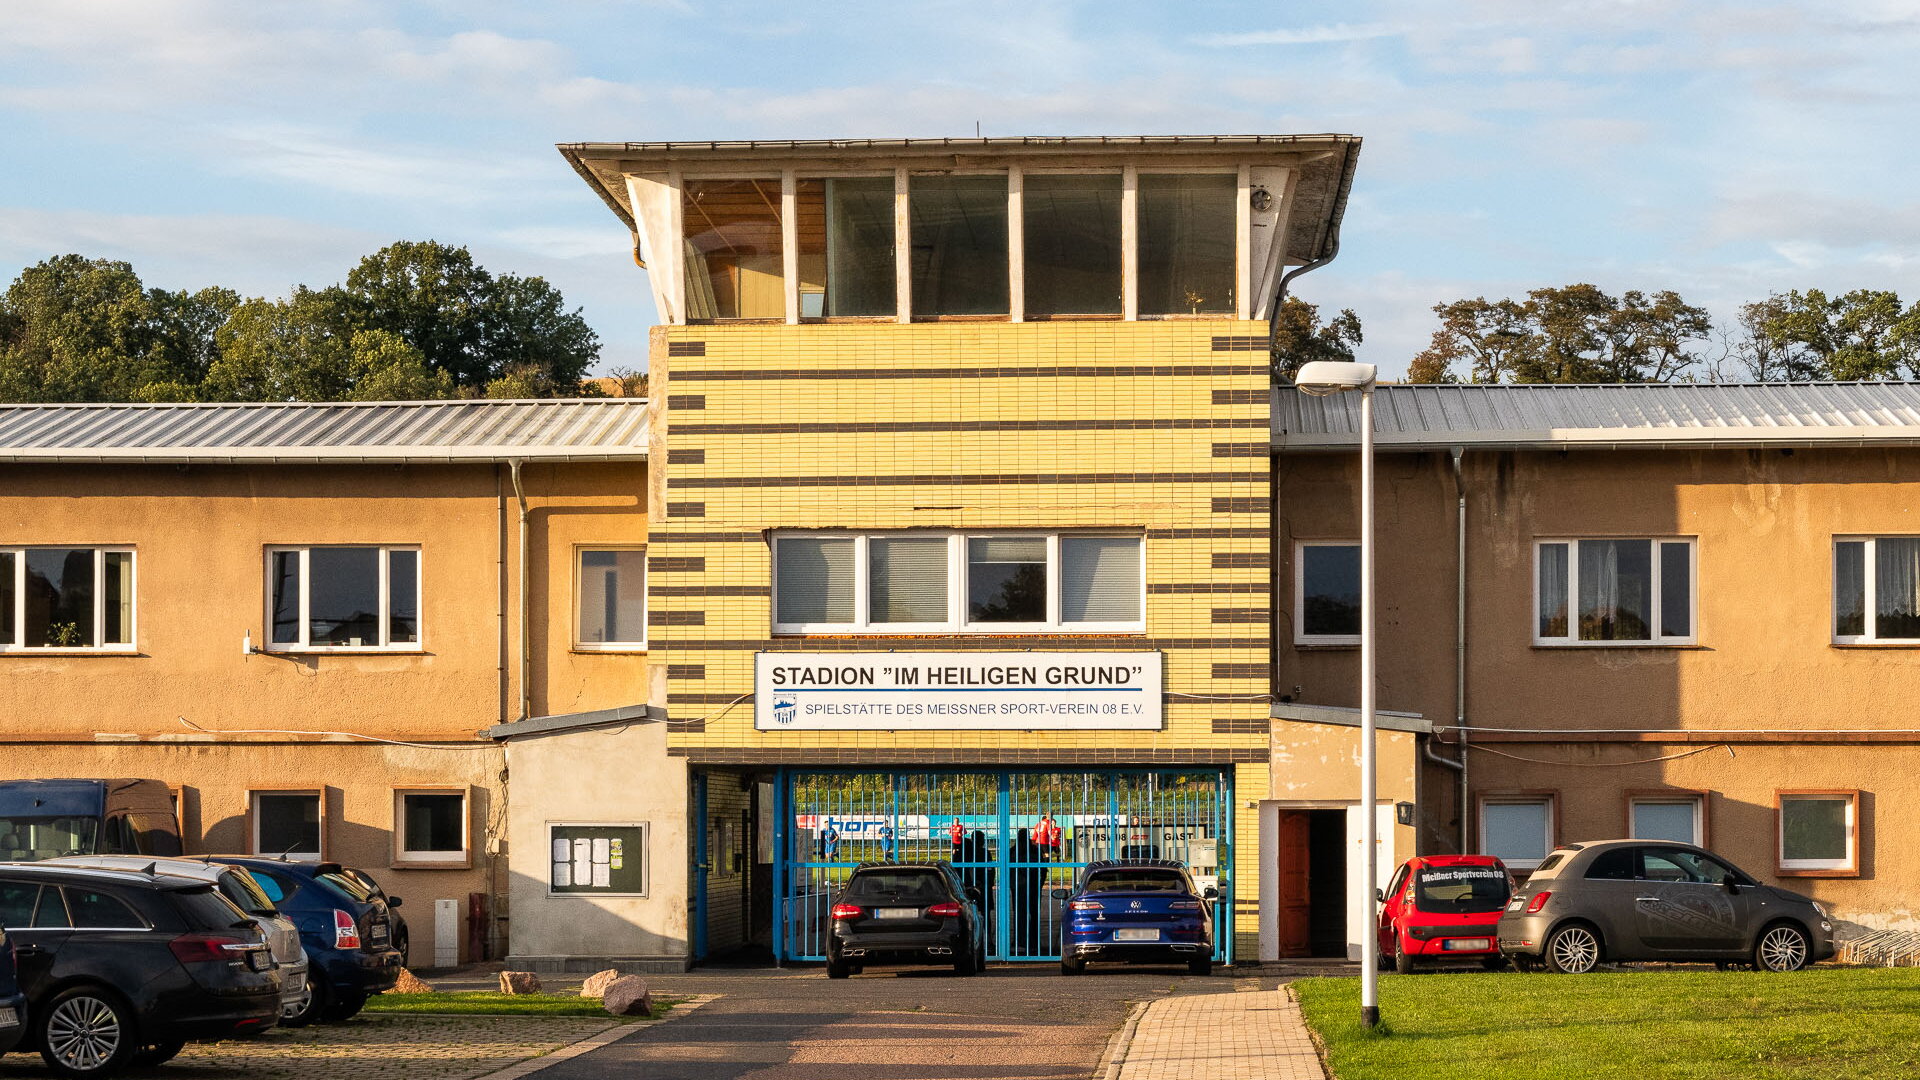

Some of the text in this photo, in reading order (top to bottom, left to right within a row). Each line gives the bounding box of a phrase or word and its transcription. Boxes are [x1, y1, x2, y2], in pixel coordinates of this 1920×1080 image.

[772, 667, 874, 685] STADION
[927, 667, 1037, 685] HEILIGEN
[805, 702, 1144, 715] SPIELSTÄTTE DES MEISSNER SPORT-VEREIN 08 E.V.
[1422, 870, 1504, 882] Meißner Sportverein 08
